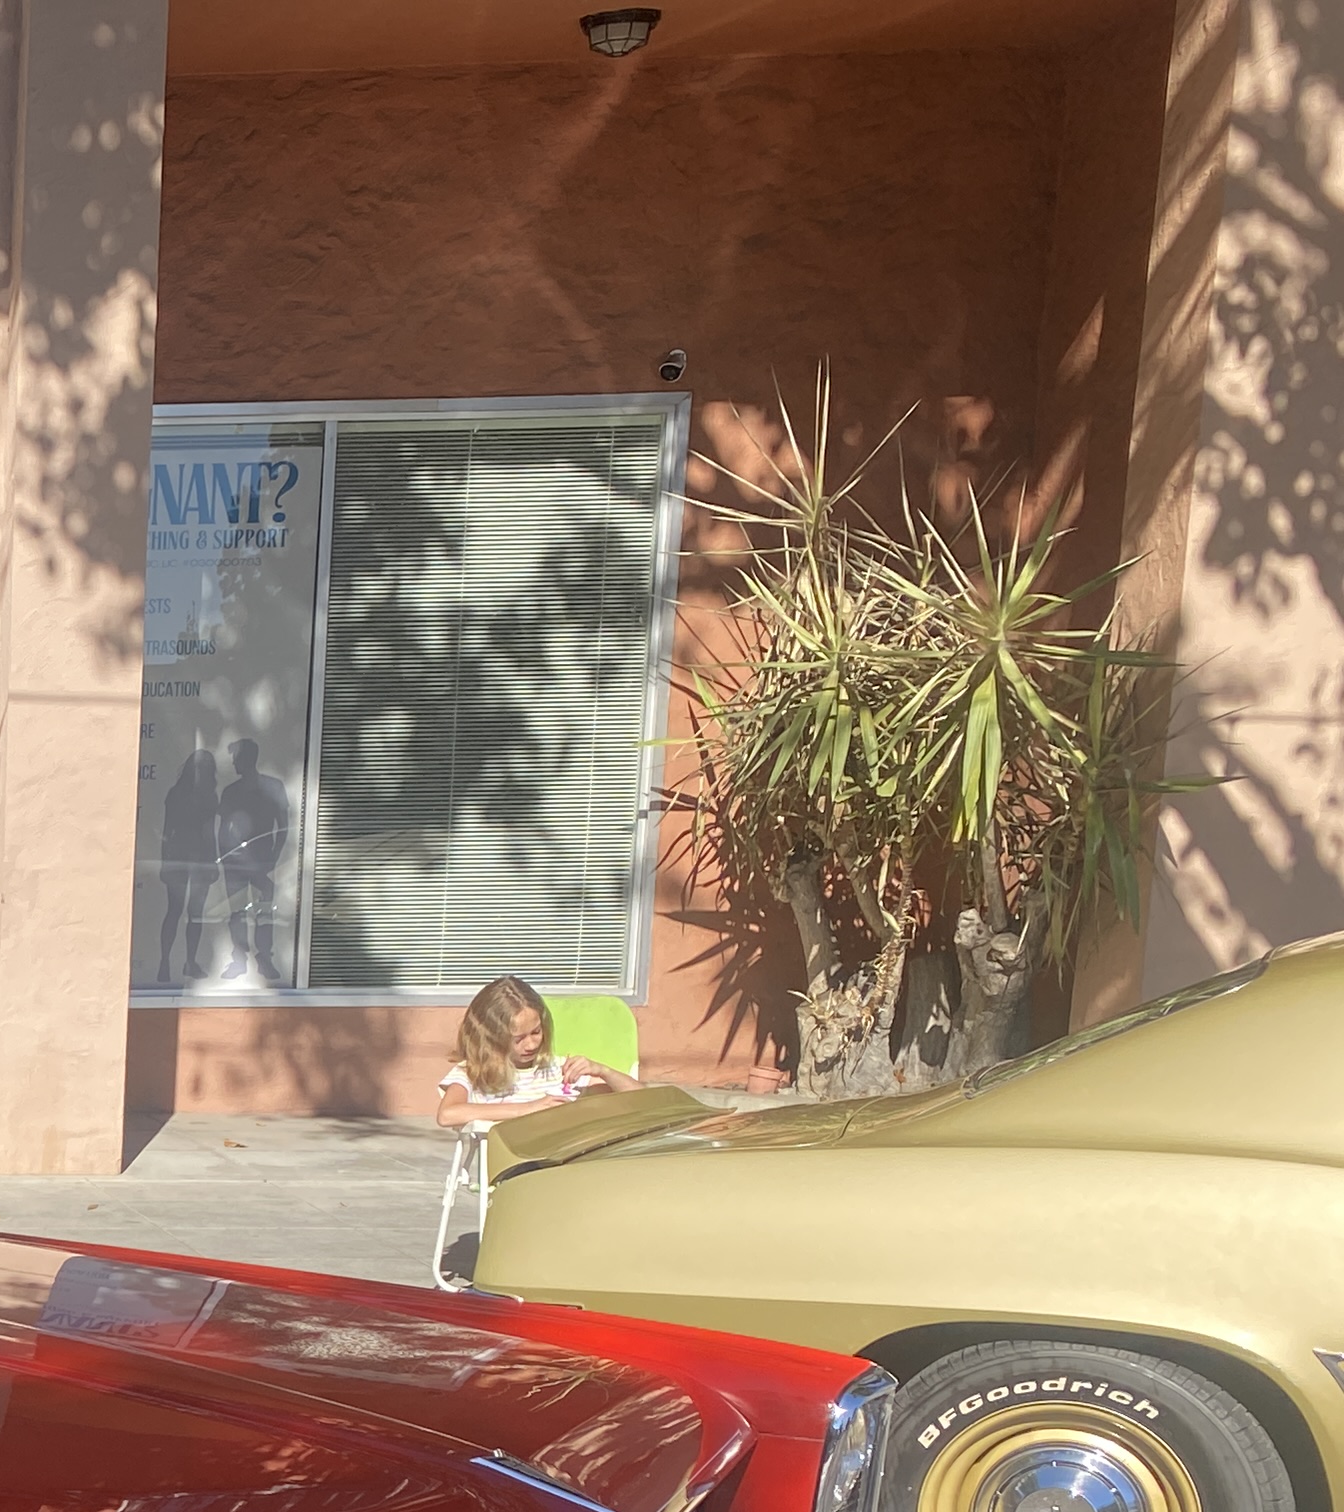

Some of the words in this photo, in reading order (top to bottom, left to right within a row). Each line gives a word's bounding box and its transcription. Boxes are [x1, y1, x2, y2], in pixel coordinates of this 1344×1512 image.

[148, 460, 299, 526] NANT?
[148, 529, 189, 551] HING
[196, 530, 208, 550] &
[212, 528, 289, 550] SUPPORT
[916, 1376, 1162, 1450] BFGoodrich
